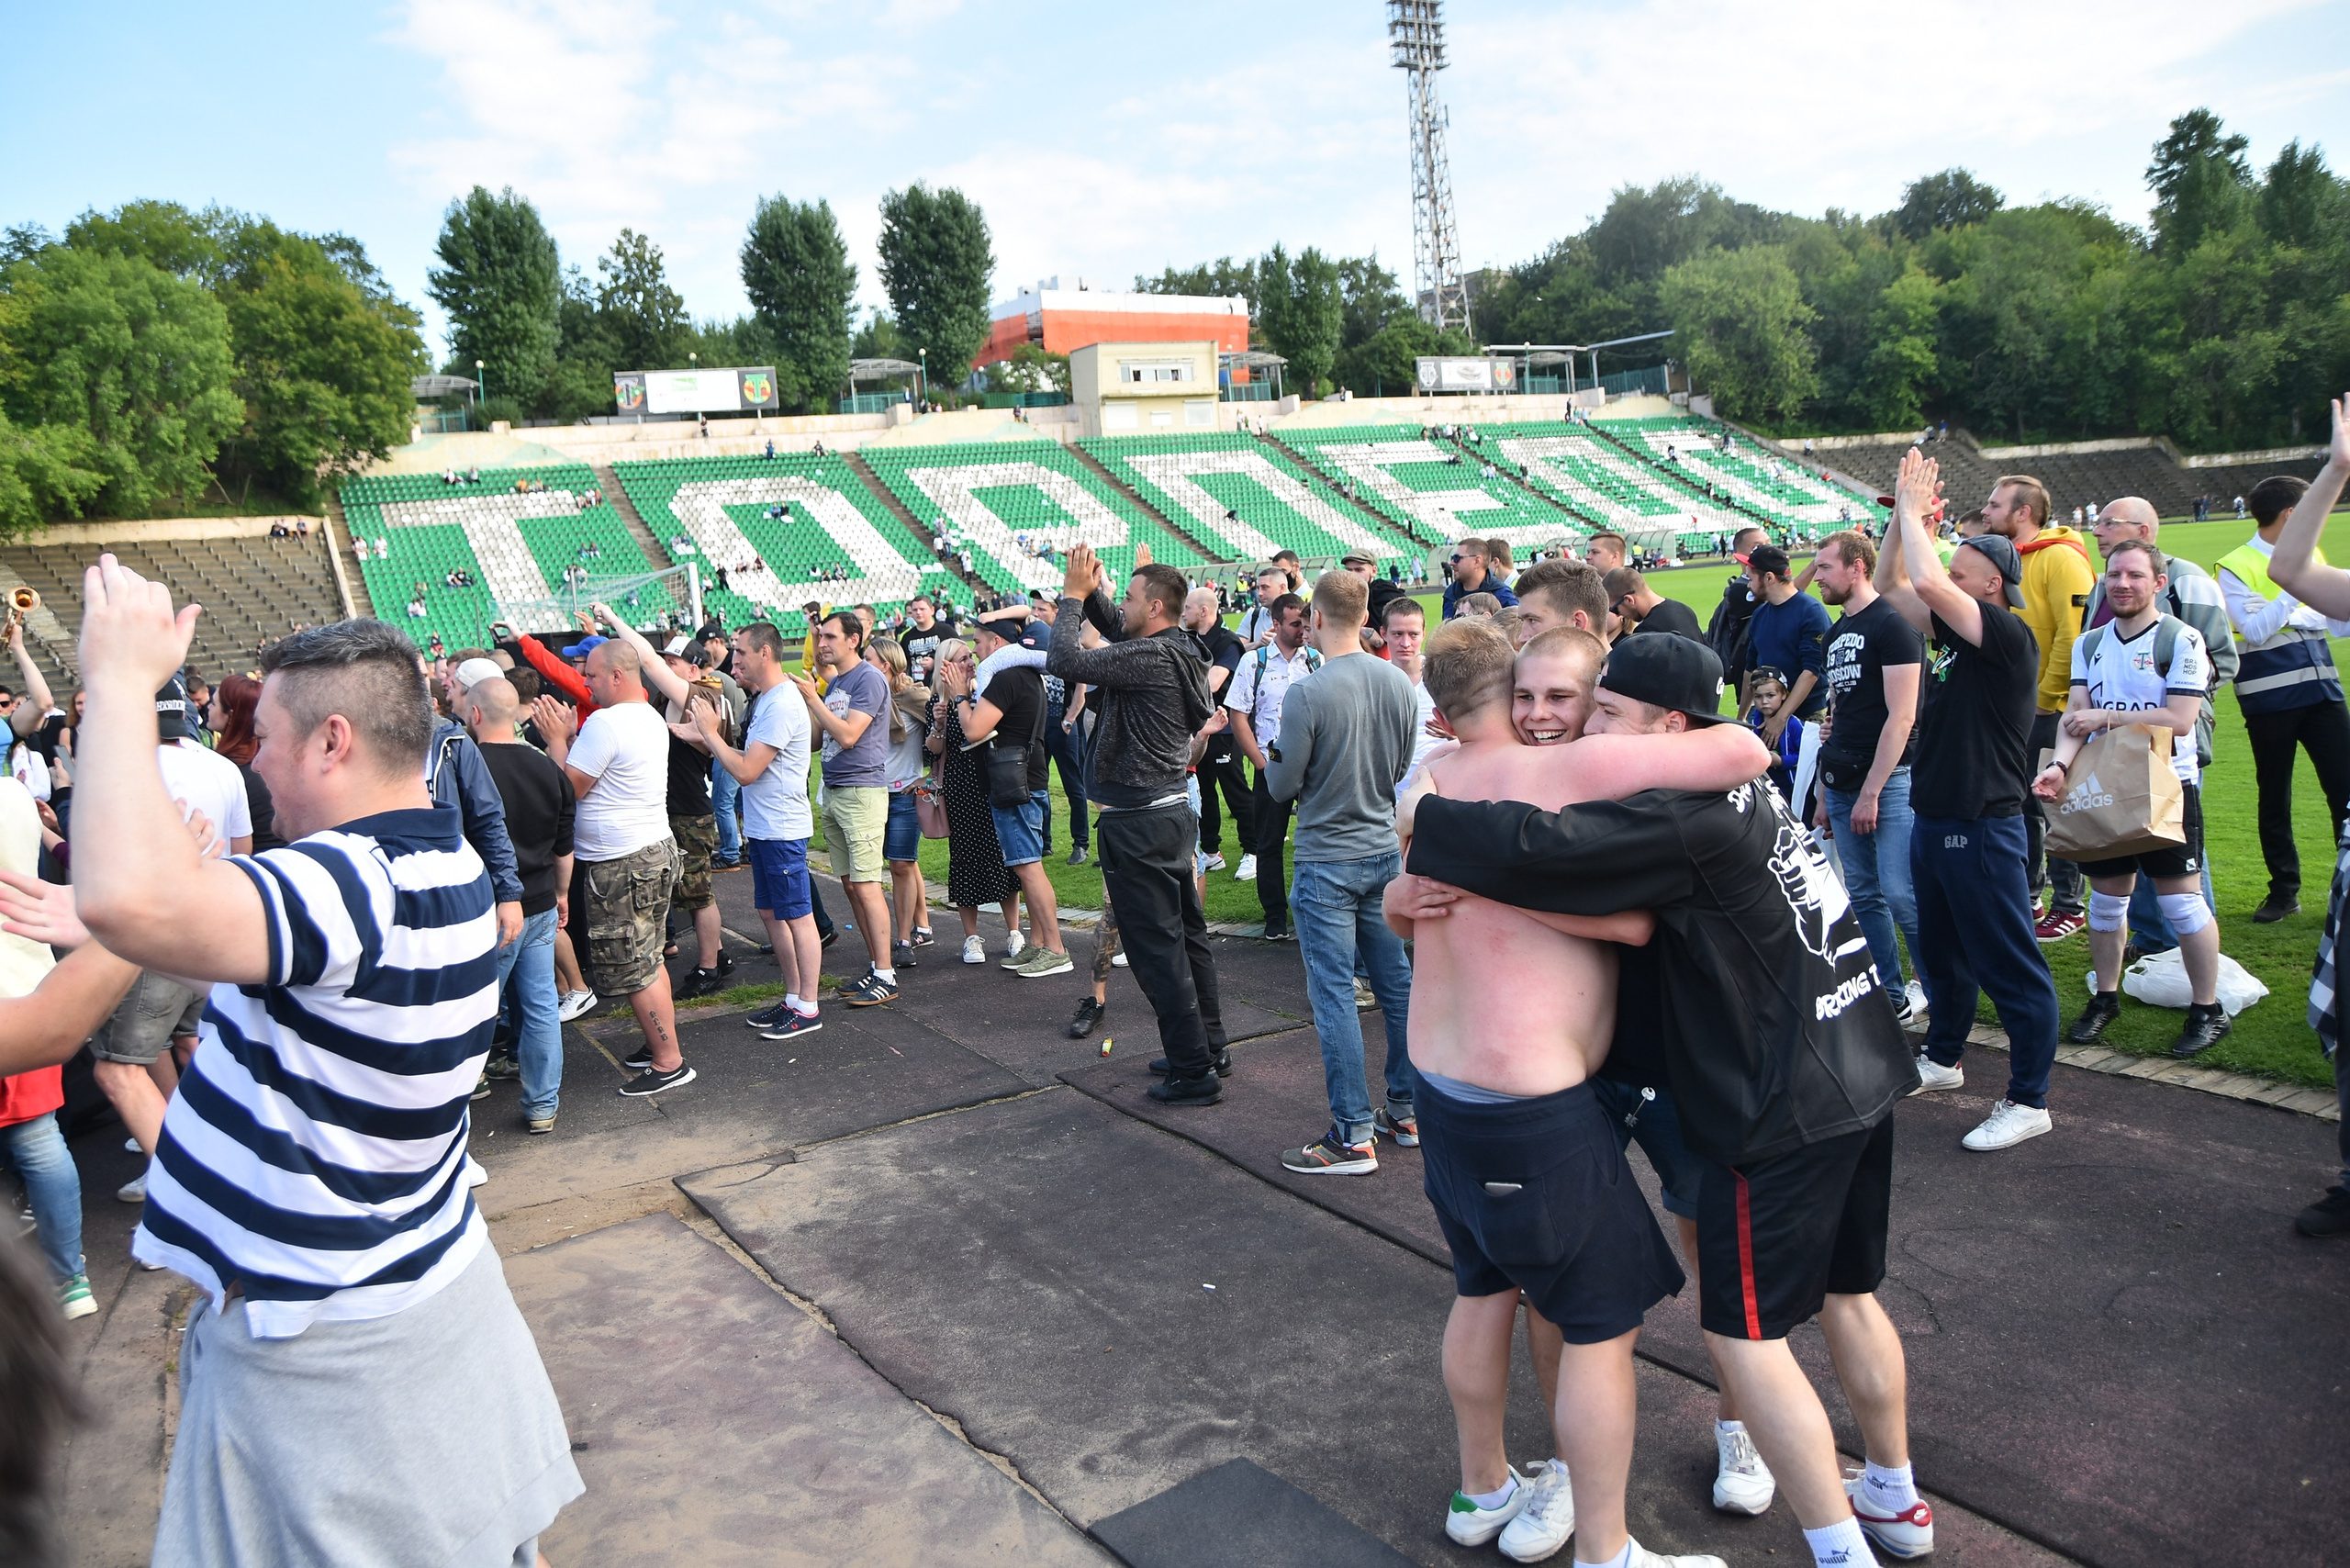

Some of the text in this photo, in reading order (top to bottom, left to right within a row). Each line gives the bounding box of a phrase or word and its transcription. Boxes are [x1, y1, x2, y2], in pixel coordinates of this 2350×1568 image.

[378, 429, 1874, 633] ТОРПЕДО
[1844, 648, 1857, 663] 24
[1827, 664, 1863, 684] MOSCOW
[2060, 793, 2114, 815] adidas
[1944, 834, 1968, 849] GAP
